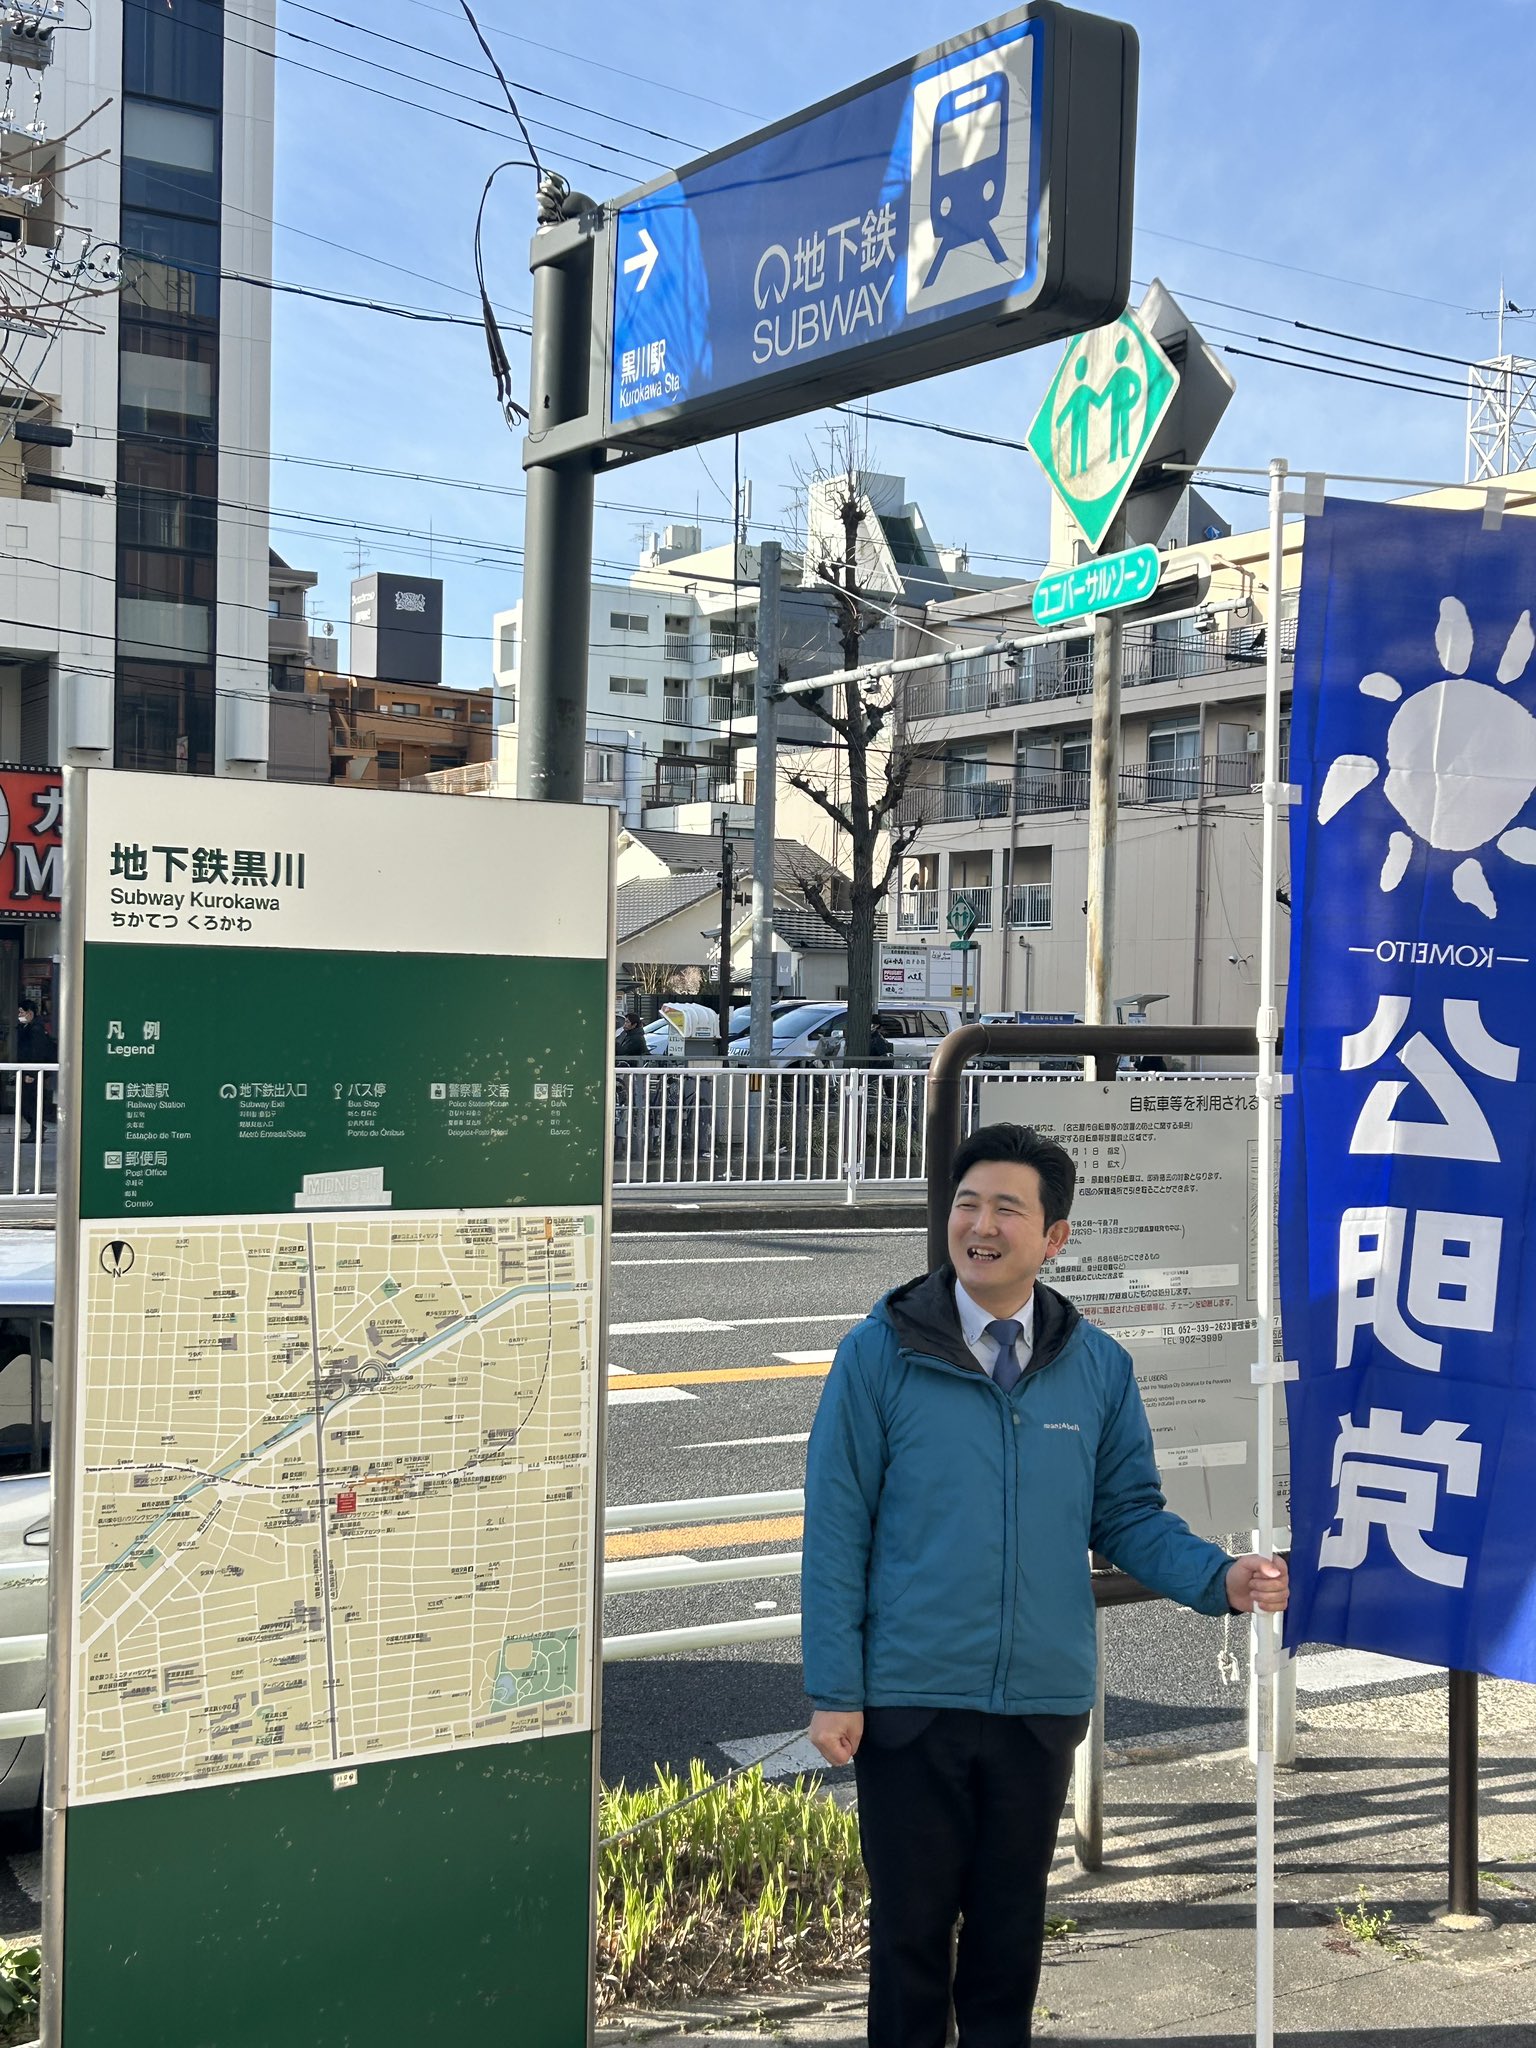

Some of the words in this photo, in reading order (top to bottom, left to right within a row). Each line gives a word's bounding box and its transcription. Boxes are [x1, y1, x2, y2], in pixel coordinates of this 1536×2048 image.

[793, 202, 897, 290] 地下鉄
[752, 275, 896, 365] SUBWAY
[620, 338, 667, 385] 黒川駅
[619, 380, 663, 409] Kurokawa
[1037, 555, 1153, 620] ユニバーサルゾーン
[109, 842, 305, 890] 地下鉄黒川
[110, 887, 185, 911] Subway
[190, 891, 281, 912] Kurokawa
[111, 911, 179, 929] ちかてつ
[187, 914, 253, 932] くろかわ
[107, 1043, 156, 1057] Legend
[126, 1082, 170, 1099] 鉄道駅
[239, 1082, 308, 1098] 地下鉄出入口
[347, 1082, 387, 1098] バス停
[448, 1082, 510, 1098] 警察署・交番
[550, 1082, 574, 1098] 銀行
[126, 1100, 158, 1111] Railway
[159, 1100, 187, 1109] Station
[240, 1100, 270, 1110] Subway
[271, 1100, 286, 1108] Exit
[347, 1100, 362, 1108] Bus
[363, 1100, 380, 1109] Stop
[125, 1150, 168, 1167] 郵便局
[125, 1168, 144, 1177] Post
[144, 1167, 168, 1177] Office
[112, 1267, 122, 1279] N
[1163, 1327, 1175, 1336] TEL
[1162, 1336, 1177, 1345] TEL
